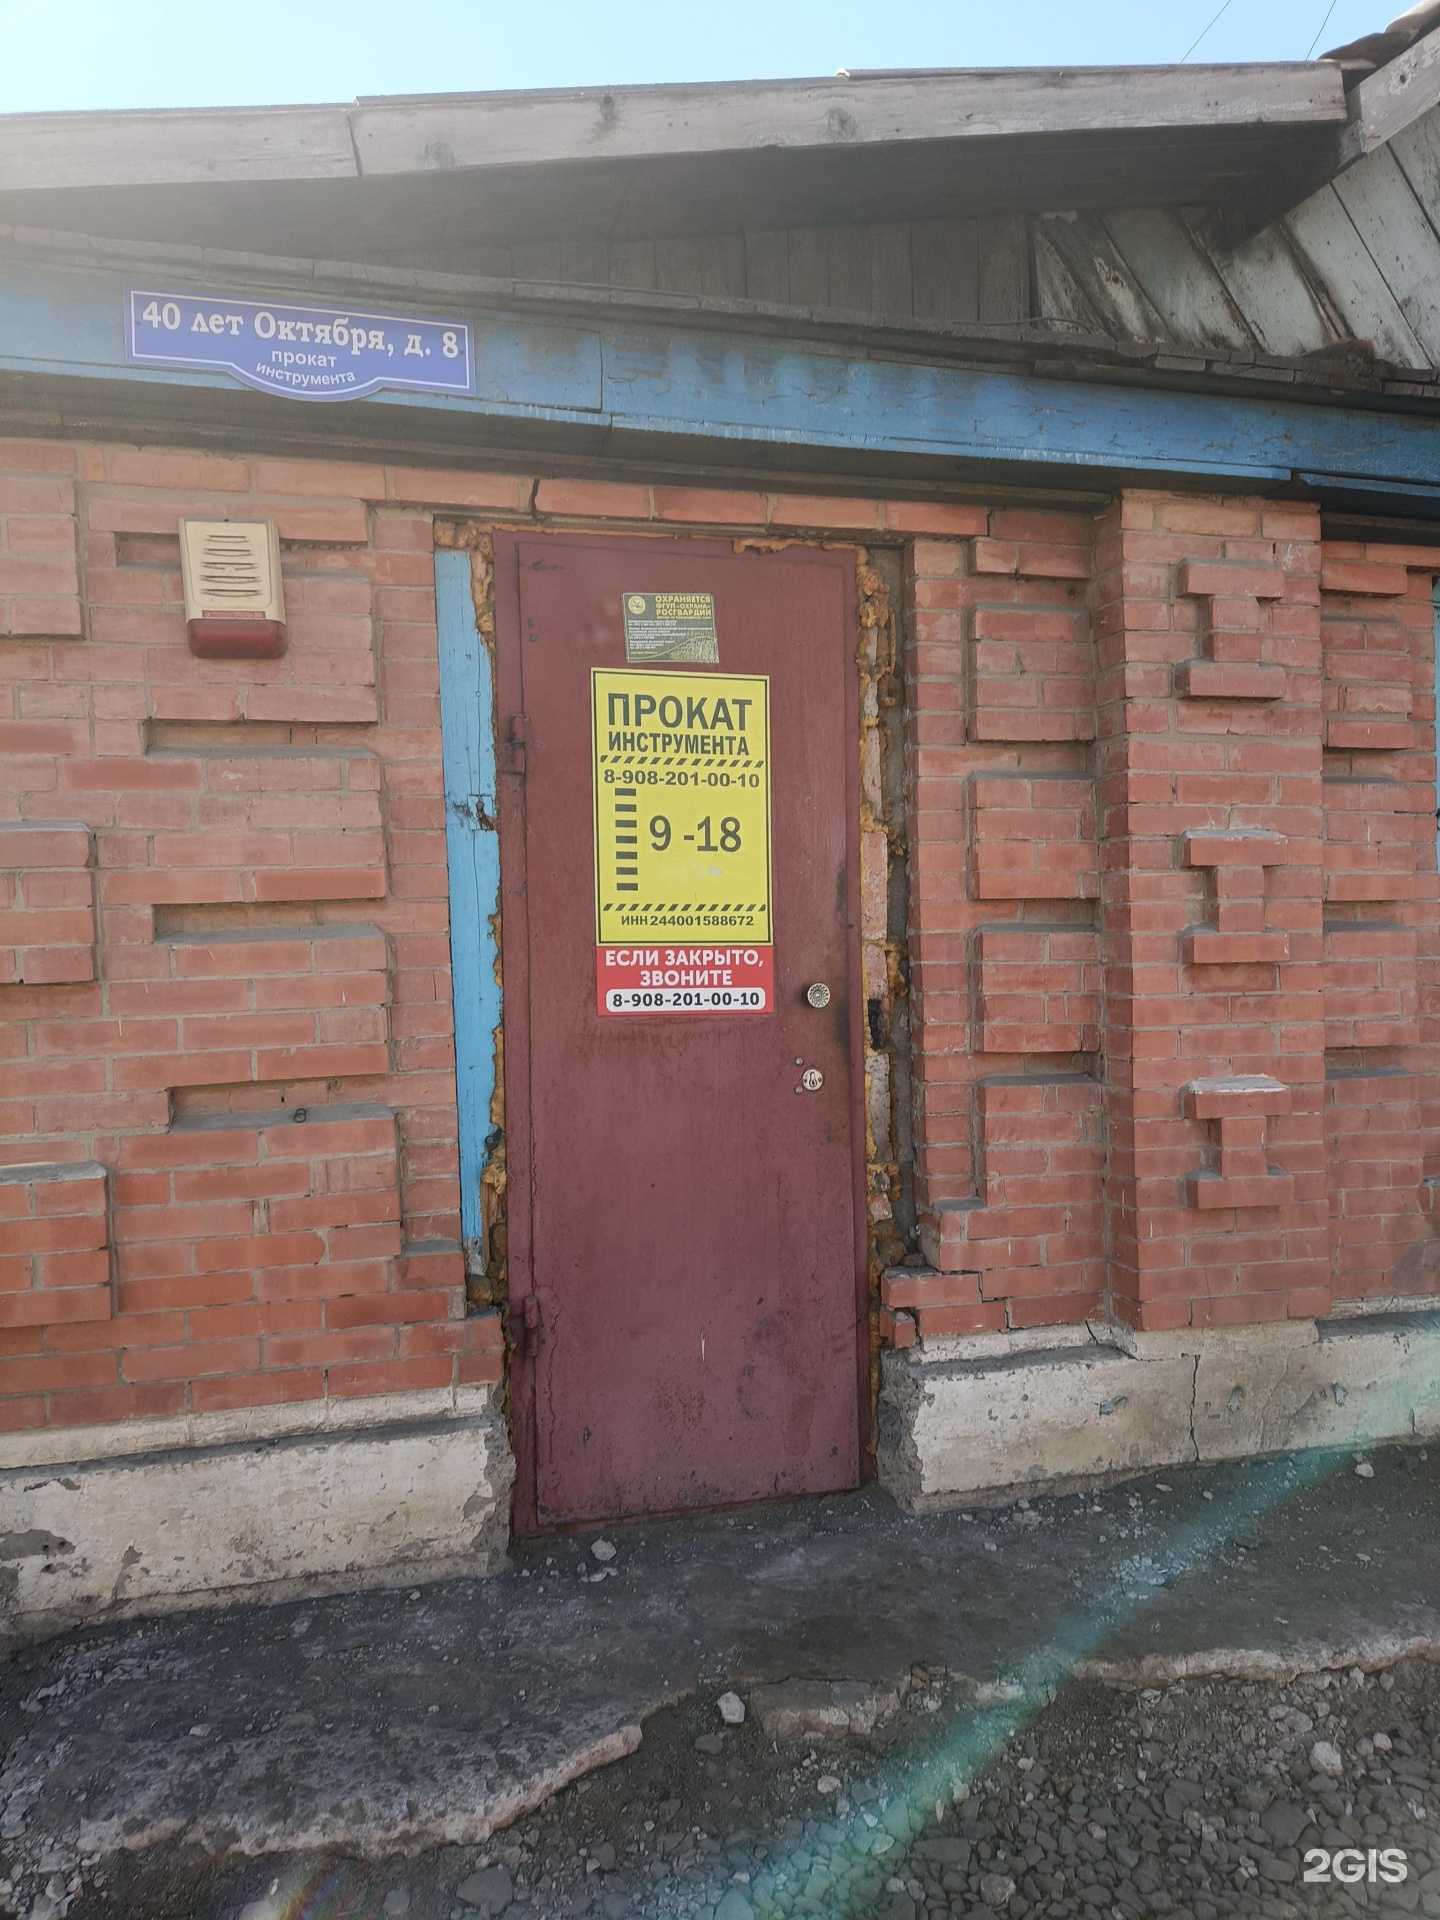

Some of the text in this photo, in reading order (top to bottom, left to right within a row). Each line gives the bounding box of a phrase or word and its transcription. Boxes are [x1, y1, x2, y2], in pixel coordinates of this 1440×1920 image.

[143, 302, 458, 358] 40 лет Октября, д. 8
[271, 349, 337, 368] прокат
[255, 362, 356, 386] инструмента
[607, 692, 753, 731] ПРОКАТ
[608, 731, 750, 756] ИНСТРУМЕНТА
[603, 769, 760, 788] 8-908-201-00-10
[649, 815, 672, 851] 9
[621, 915, 648, 926] ИНН
[605, 949, 764, 967] ЕСЛИ ЗАКРЫТО,
[640, 970, 733, 986] ЗВОНИТЕ
[612, 992, 760, 1007] 8-908-201-00-10
